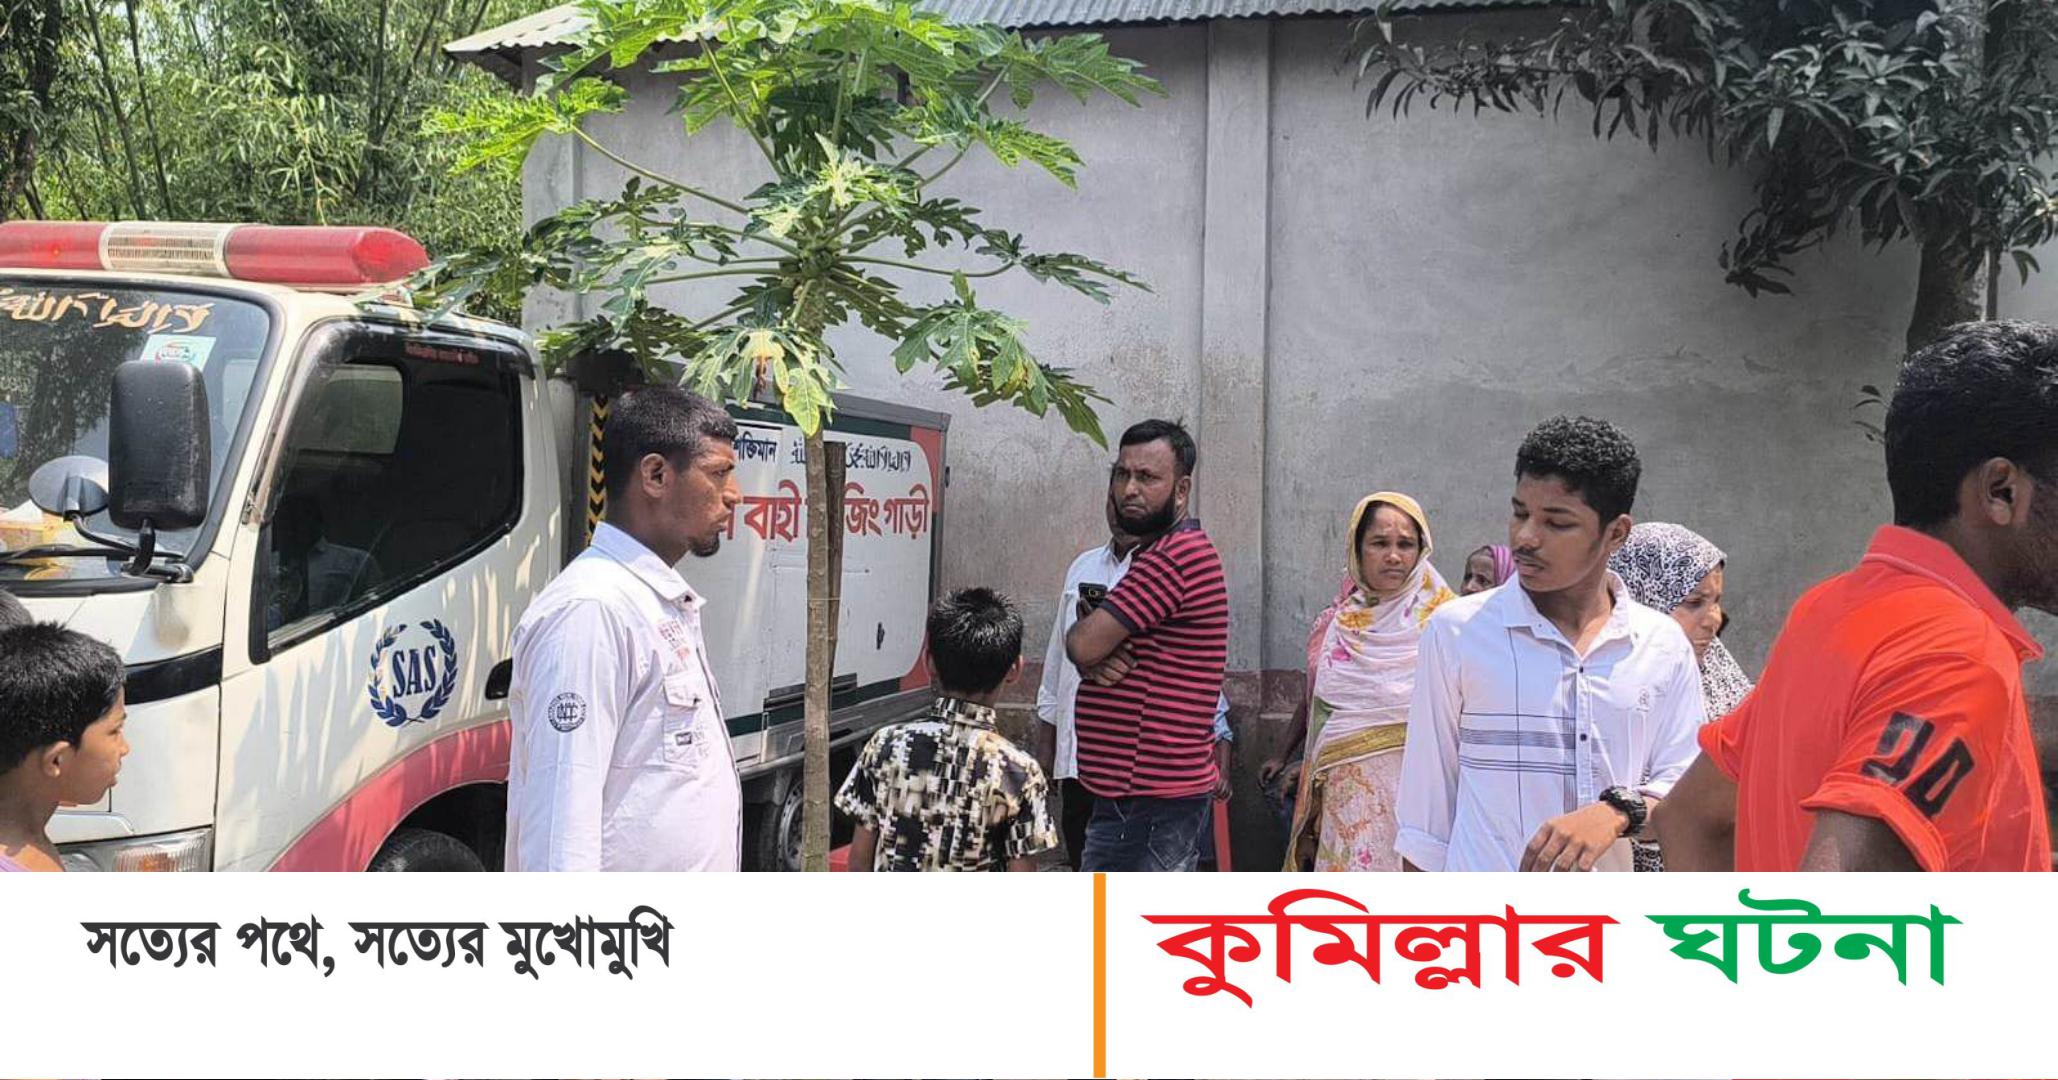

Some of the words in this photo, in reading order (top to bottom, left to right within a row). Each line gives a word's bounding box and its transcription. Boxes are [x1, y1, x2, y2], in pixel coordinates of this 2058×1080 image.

[742, 479, 801, 543] বাহী
[883, 483, 930, 540] গাড়ী
[392, 645, 436, 698] SAS
